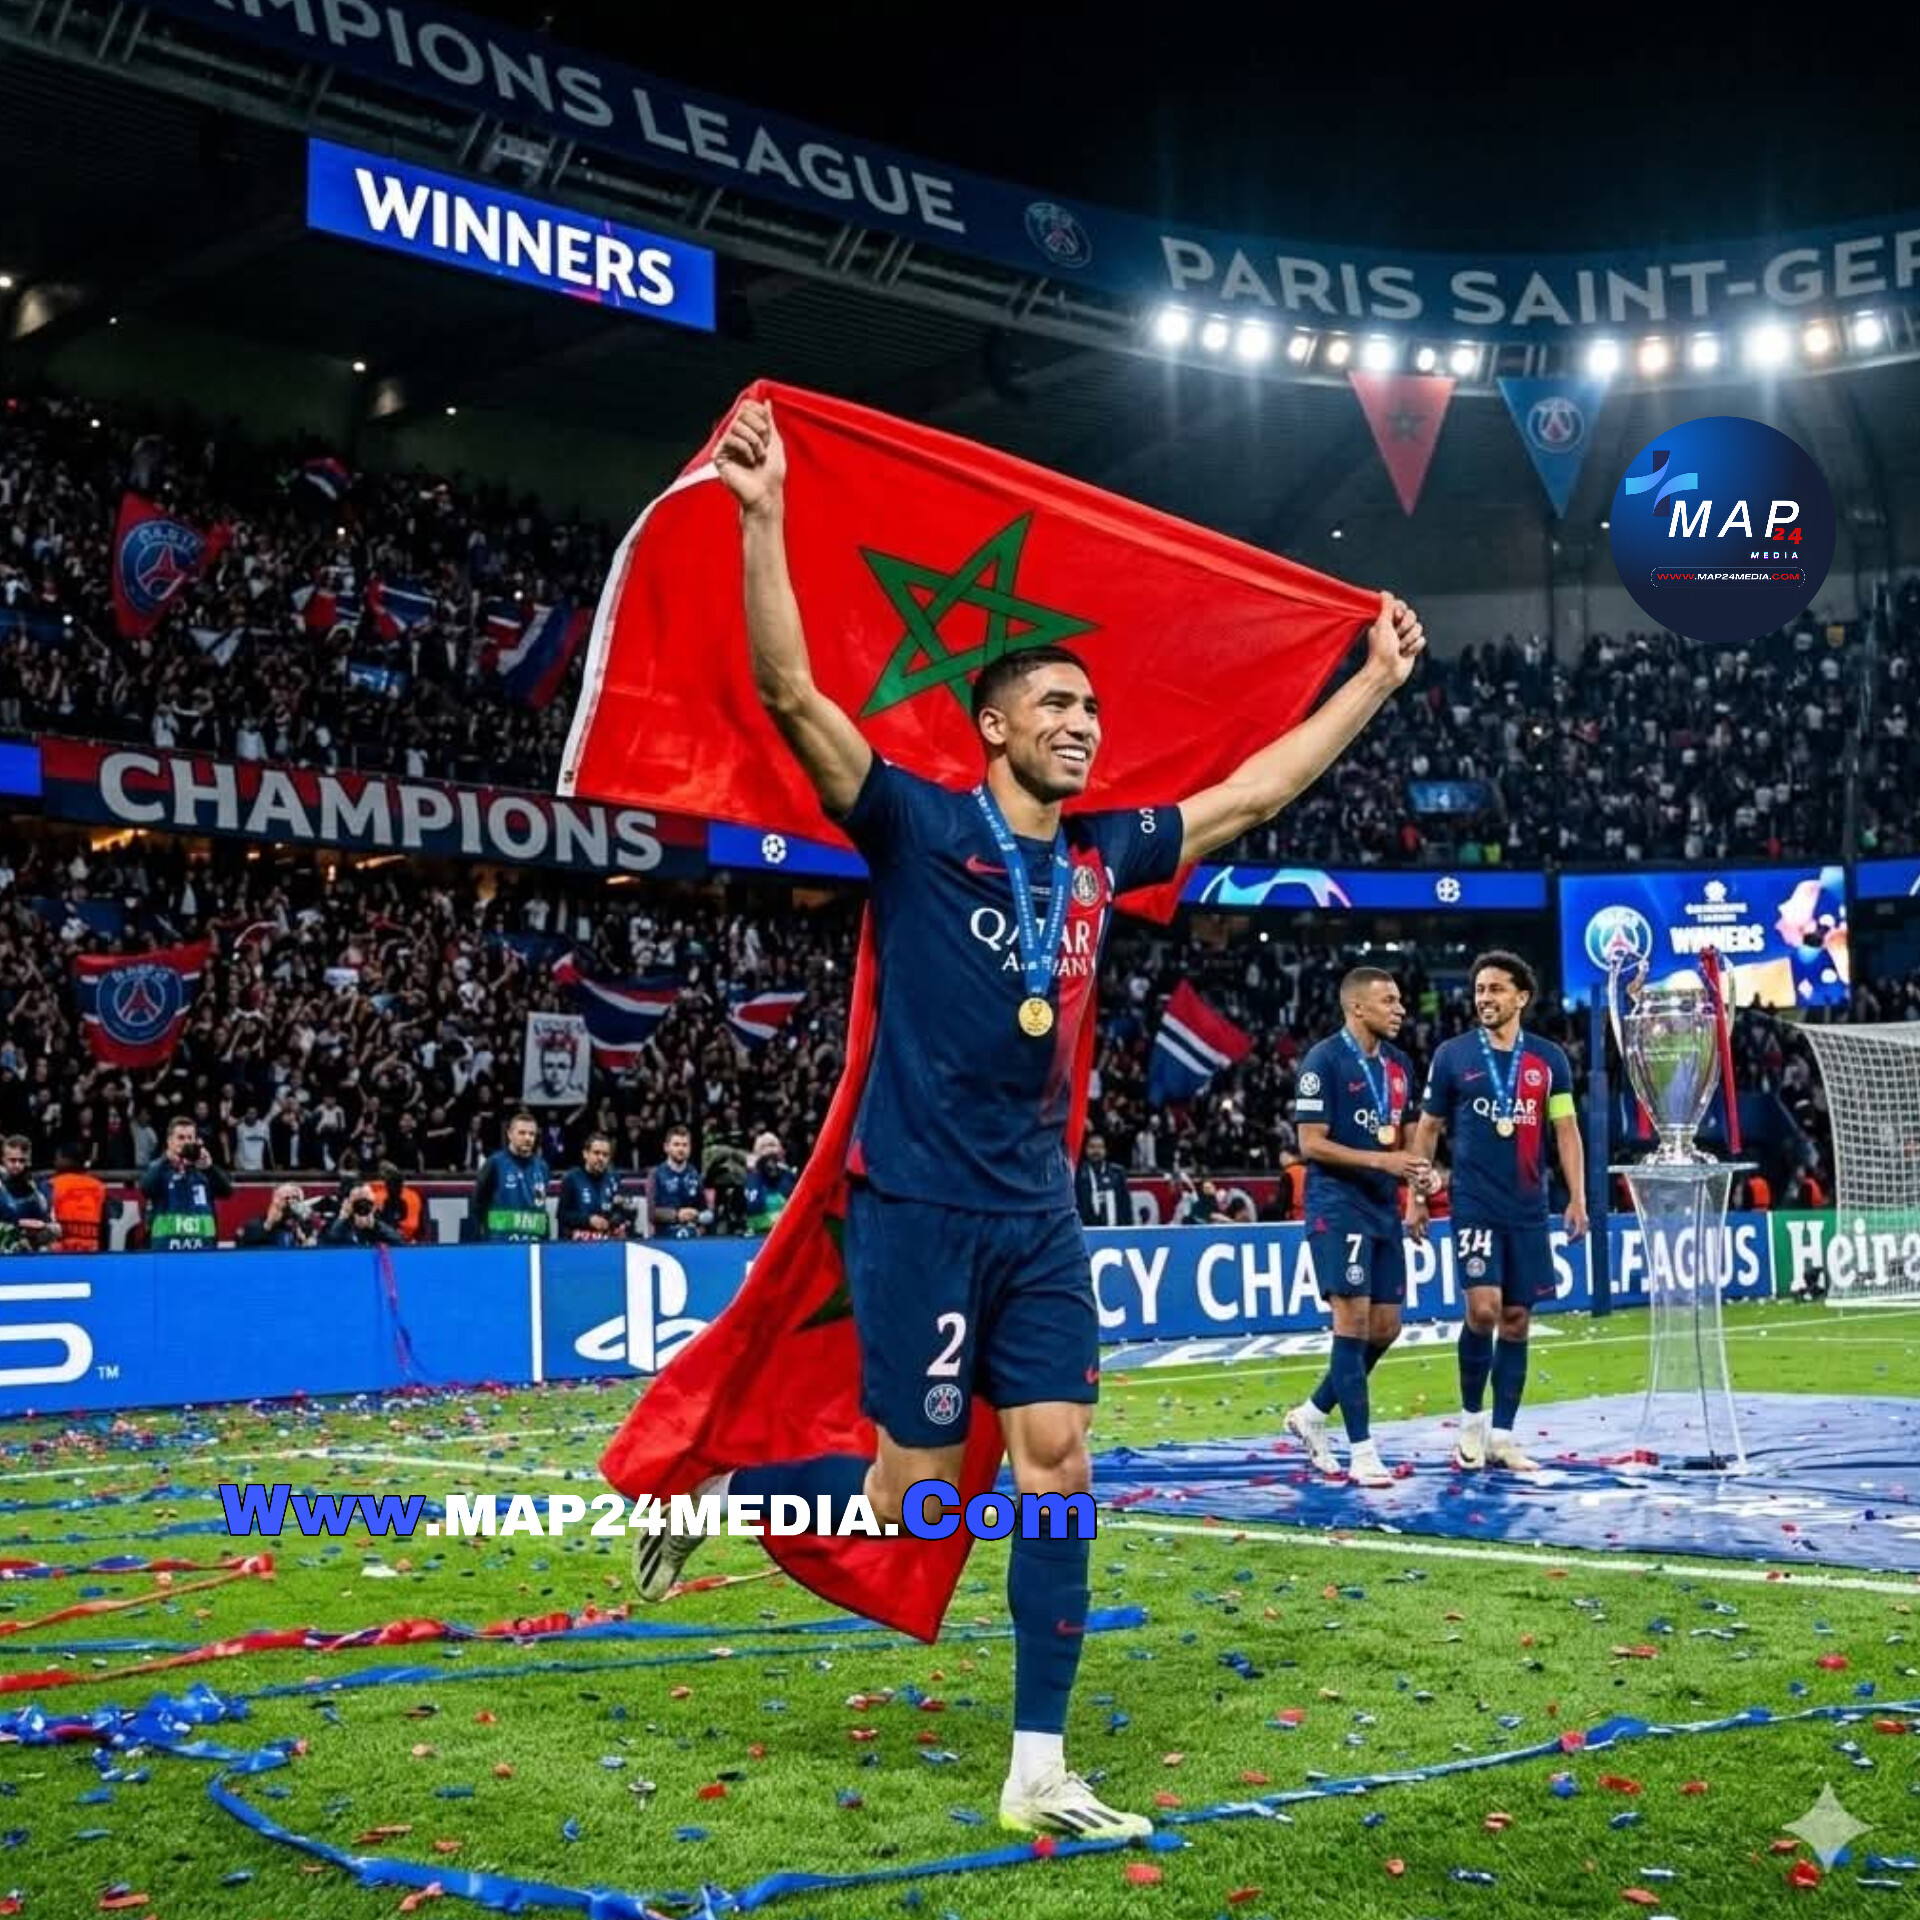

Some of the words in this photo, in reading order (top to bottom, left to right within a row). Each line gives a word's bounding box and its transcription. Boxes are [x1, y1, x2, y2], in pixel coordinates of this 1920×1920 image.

[632, 88, 965, 234] LEAGUE
[354, 167, 675, 307] WINNERS
[1160, 235, 1421, 322] PARIS
[100, 751, 662, 872] CHAMPIONS
[1346, 1233, 1363, 1263] 7
[1457, 1228, 1493, 1258] 34
[926, 1311, 967, 1377] 2
